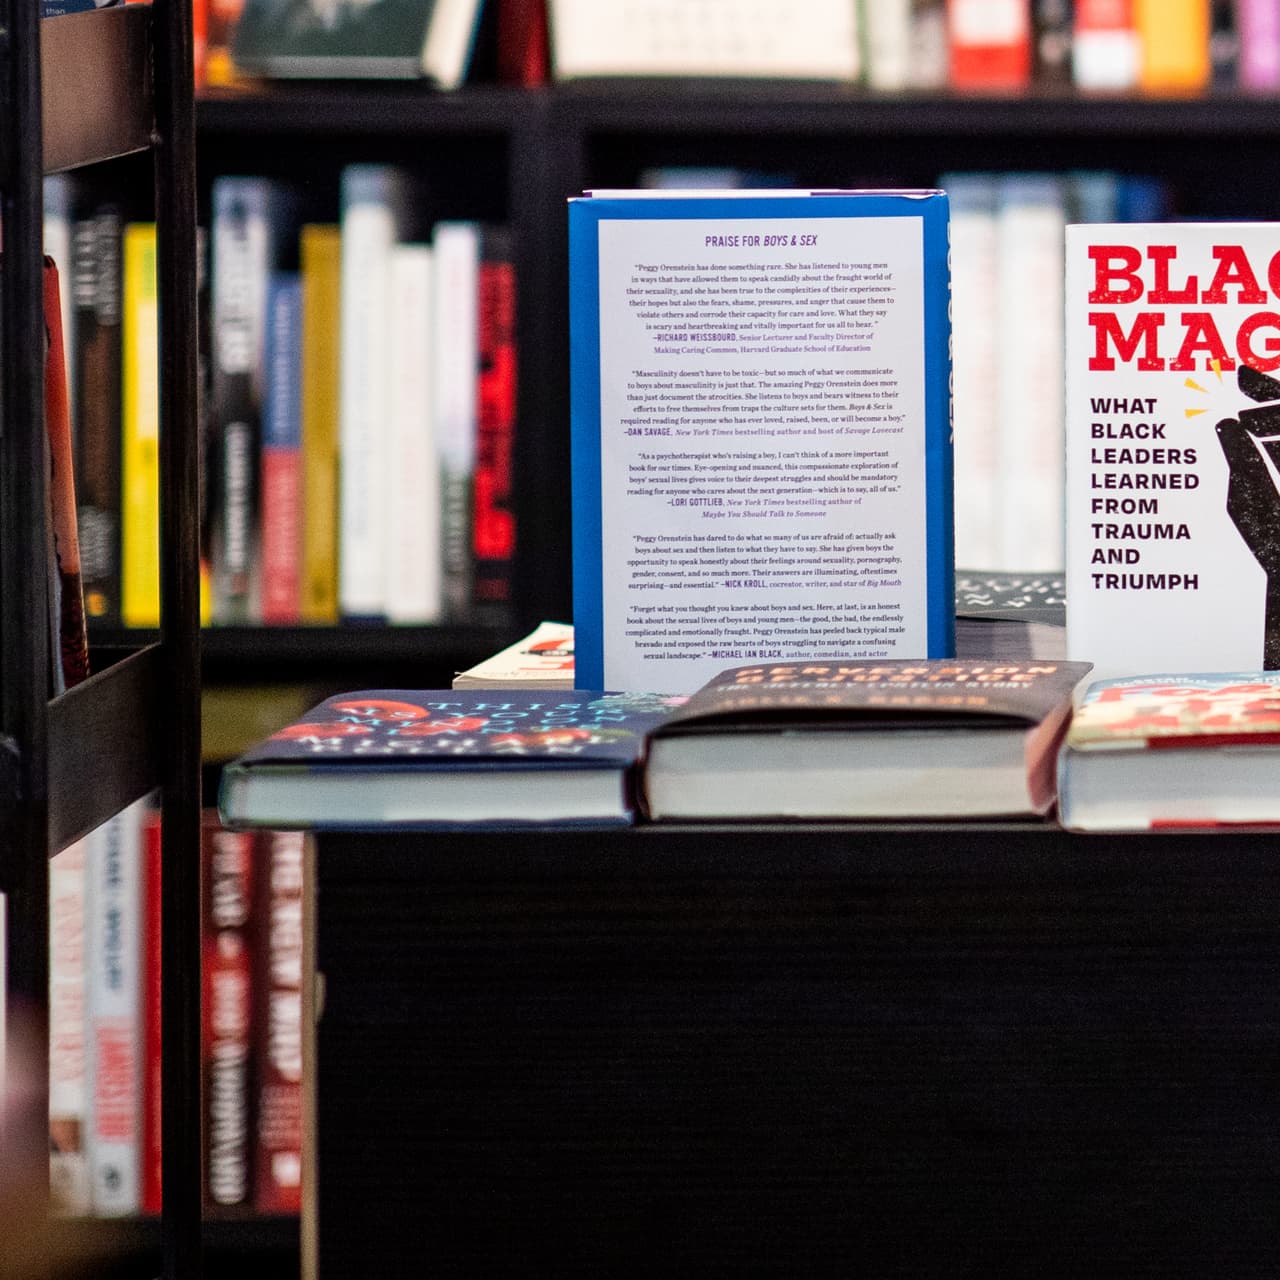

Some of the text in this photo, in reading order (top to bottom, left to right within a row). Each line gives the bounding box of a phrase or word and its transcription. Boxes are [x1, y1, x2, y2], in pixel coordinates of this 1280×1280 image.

[705, 235, 818, 247] PRAISE FOR BOYS & SEX
[696, 263, 708, 271] has
[709, 263, 726, 271] done
[728, 263, 765, 272] something
[798, 262, 810, 270] has
[812, 262, 840, 270] listened
[841, 262, 848, 270] to
[850, 264, 871, 272] young
[1090, 398, 1158, 414] WHAT
[1090, 423, 1166, 439] BLACK
[1091, 448, 1197, 464] LEADERS
[1091, 473, 1200, 489] LEARNED
[1091, 498, 1158, 514] FROM
[1091, 523, 1191, 540] TRAUMA
[1091, 548, 1140, 565] AND
[1091, 573, 1199, 590] TRIUMPH
